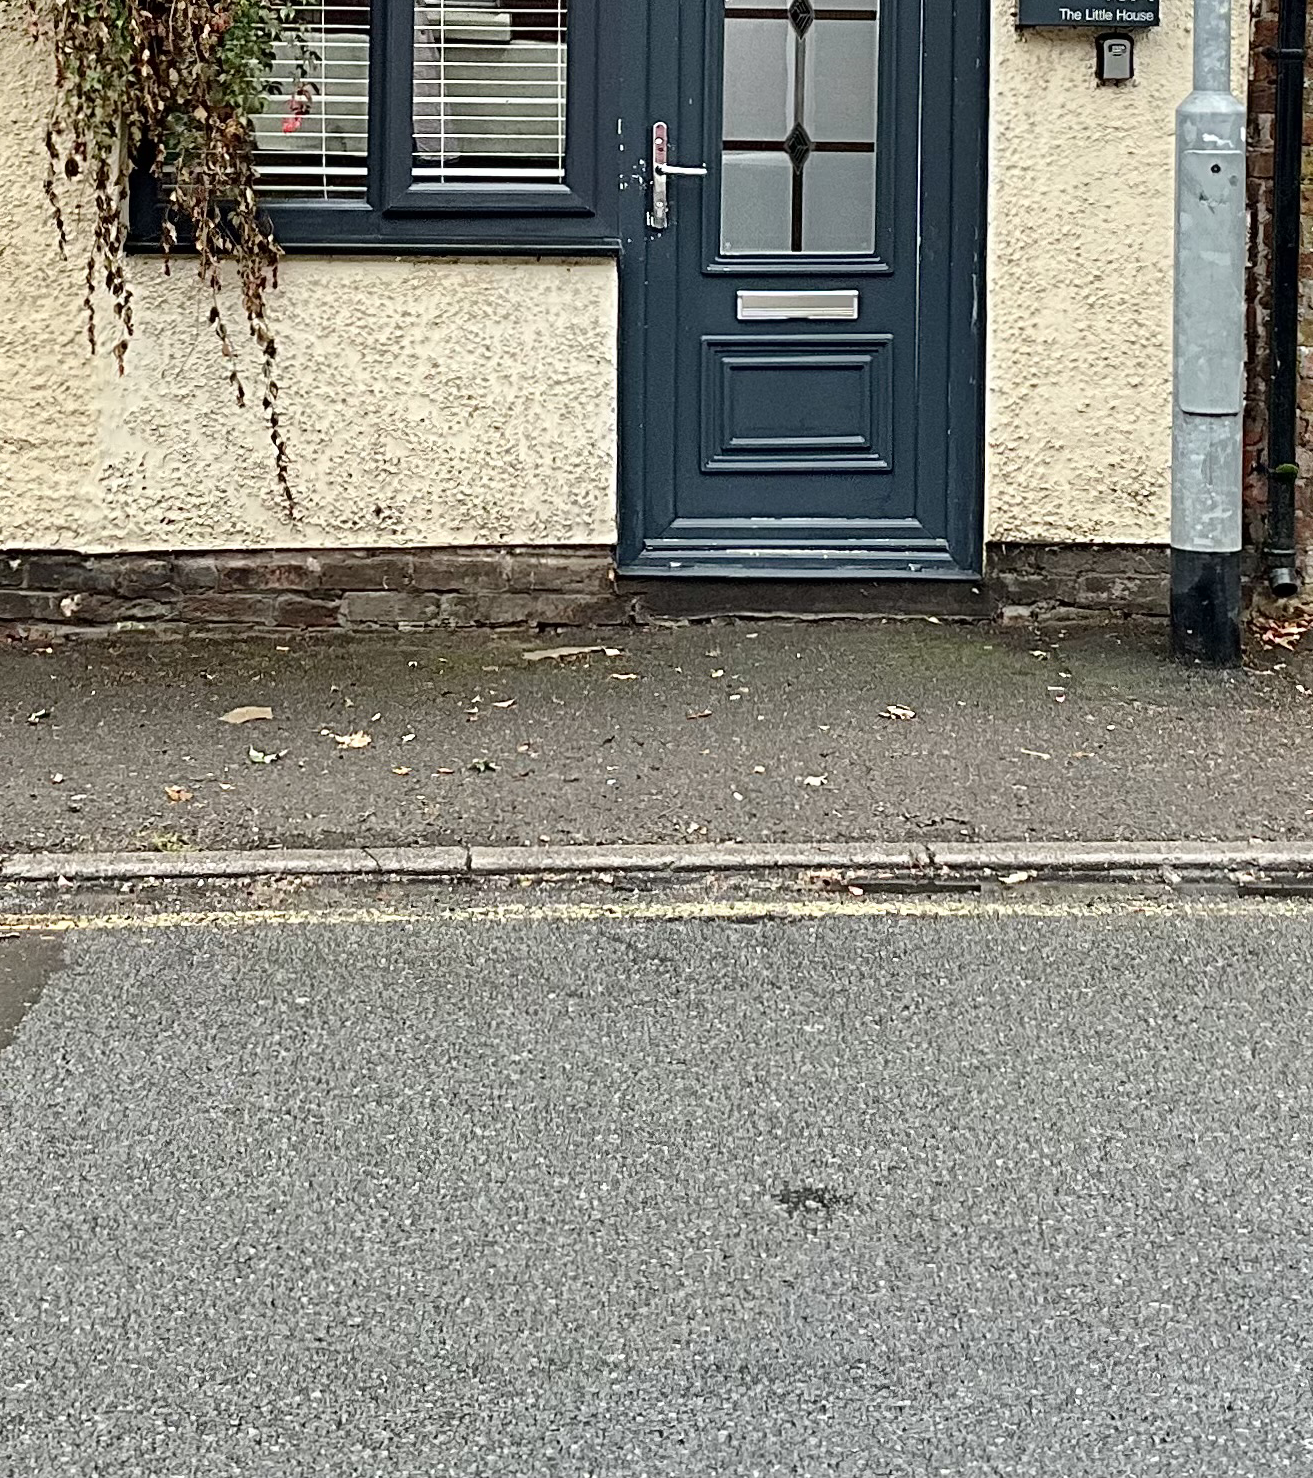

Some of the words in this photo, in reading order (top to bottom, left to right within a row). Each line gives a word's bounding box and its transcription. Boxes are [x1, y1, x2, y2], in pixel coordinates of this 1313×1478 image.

[1059, 8, 1082, 21] The
[1085, 8, 1114, 21] Little
[1116, 8, 1154, 22] House
